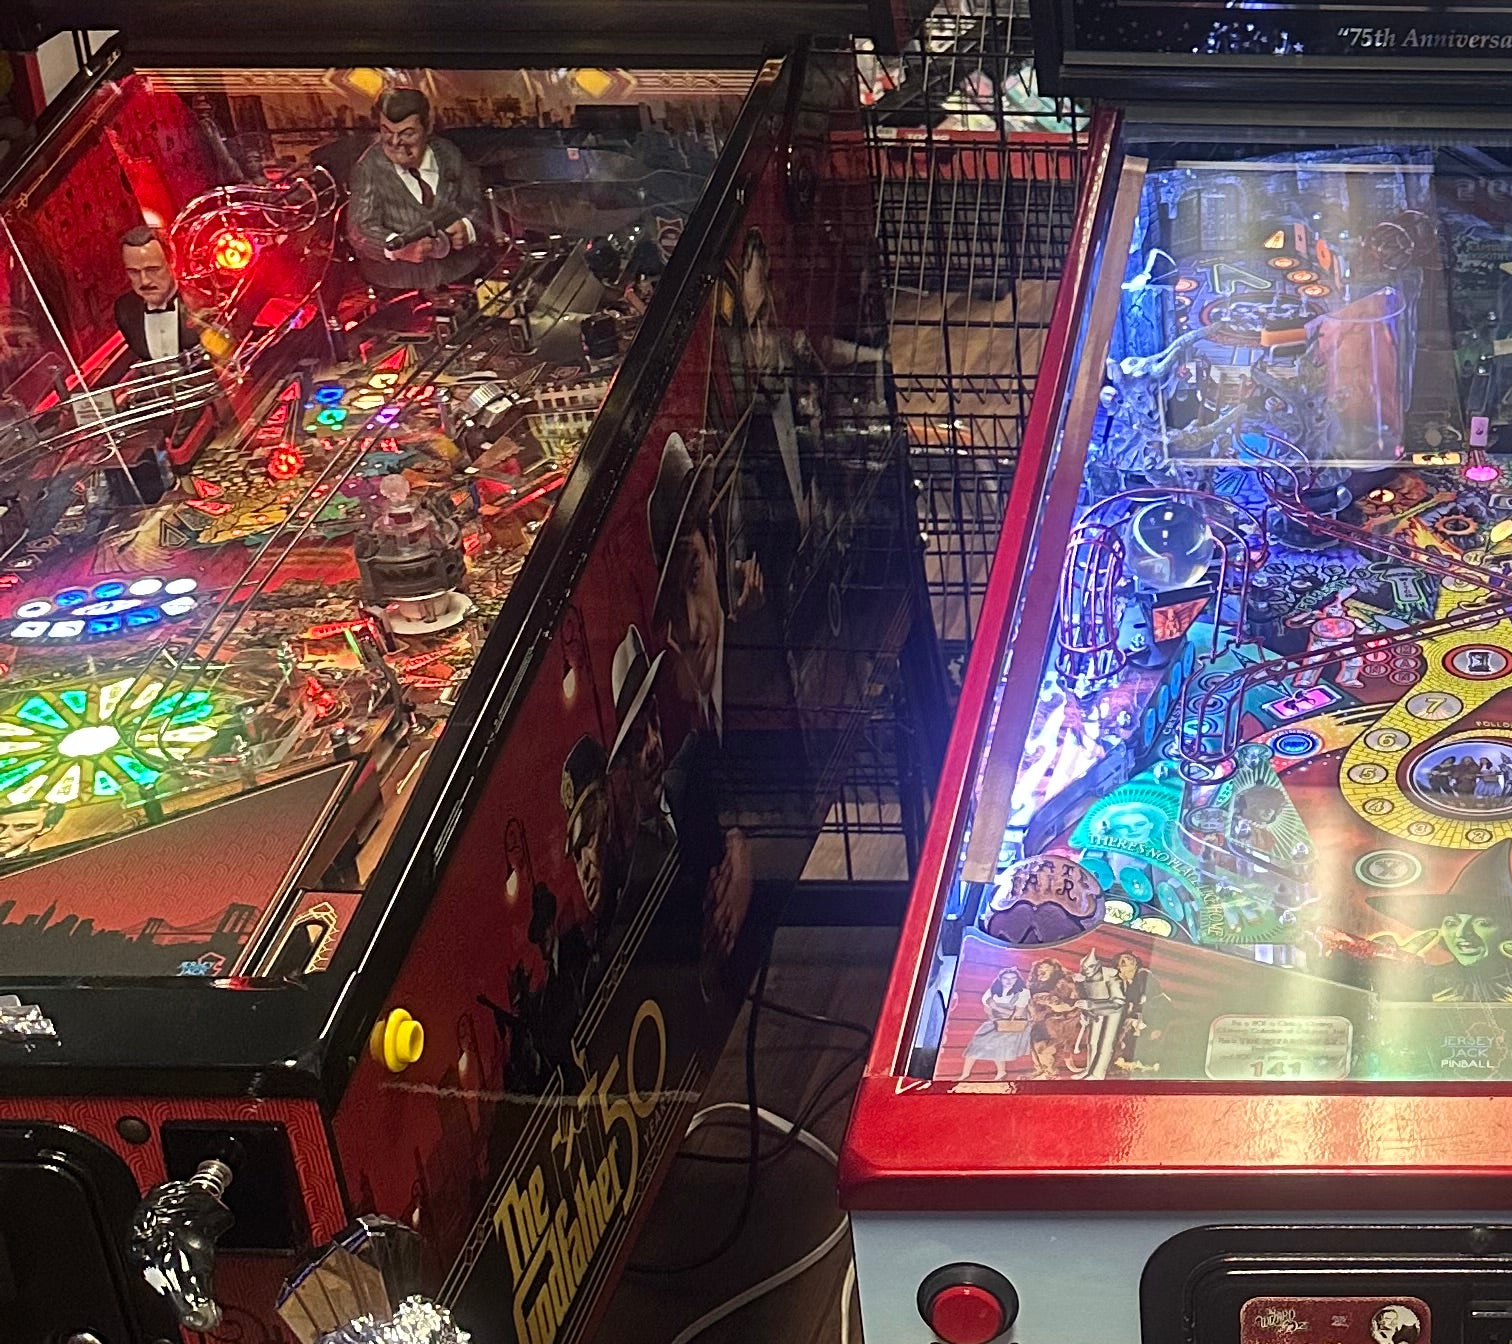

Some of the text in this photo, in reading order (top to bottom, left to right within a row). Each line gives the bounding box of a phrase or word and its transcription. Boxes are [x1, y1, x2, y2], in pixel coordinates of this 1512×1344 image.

[1424, 696, 1448, 714] 7
[1377, 731, 1397, 748] 6
[1360, 767, 1378, 780] 5
[1440, 1035, 1495, 1048] JERSEY
[1449, 1047, 1489, 1058] JACK
[1440, 1059, 1496, 1069] PINBALL
[598, 998, 667, 1217] 50
[492, 1164, 550, 1290] The
